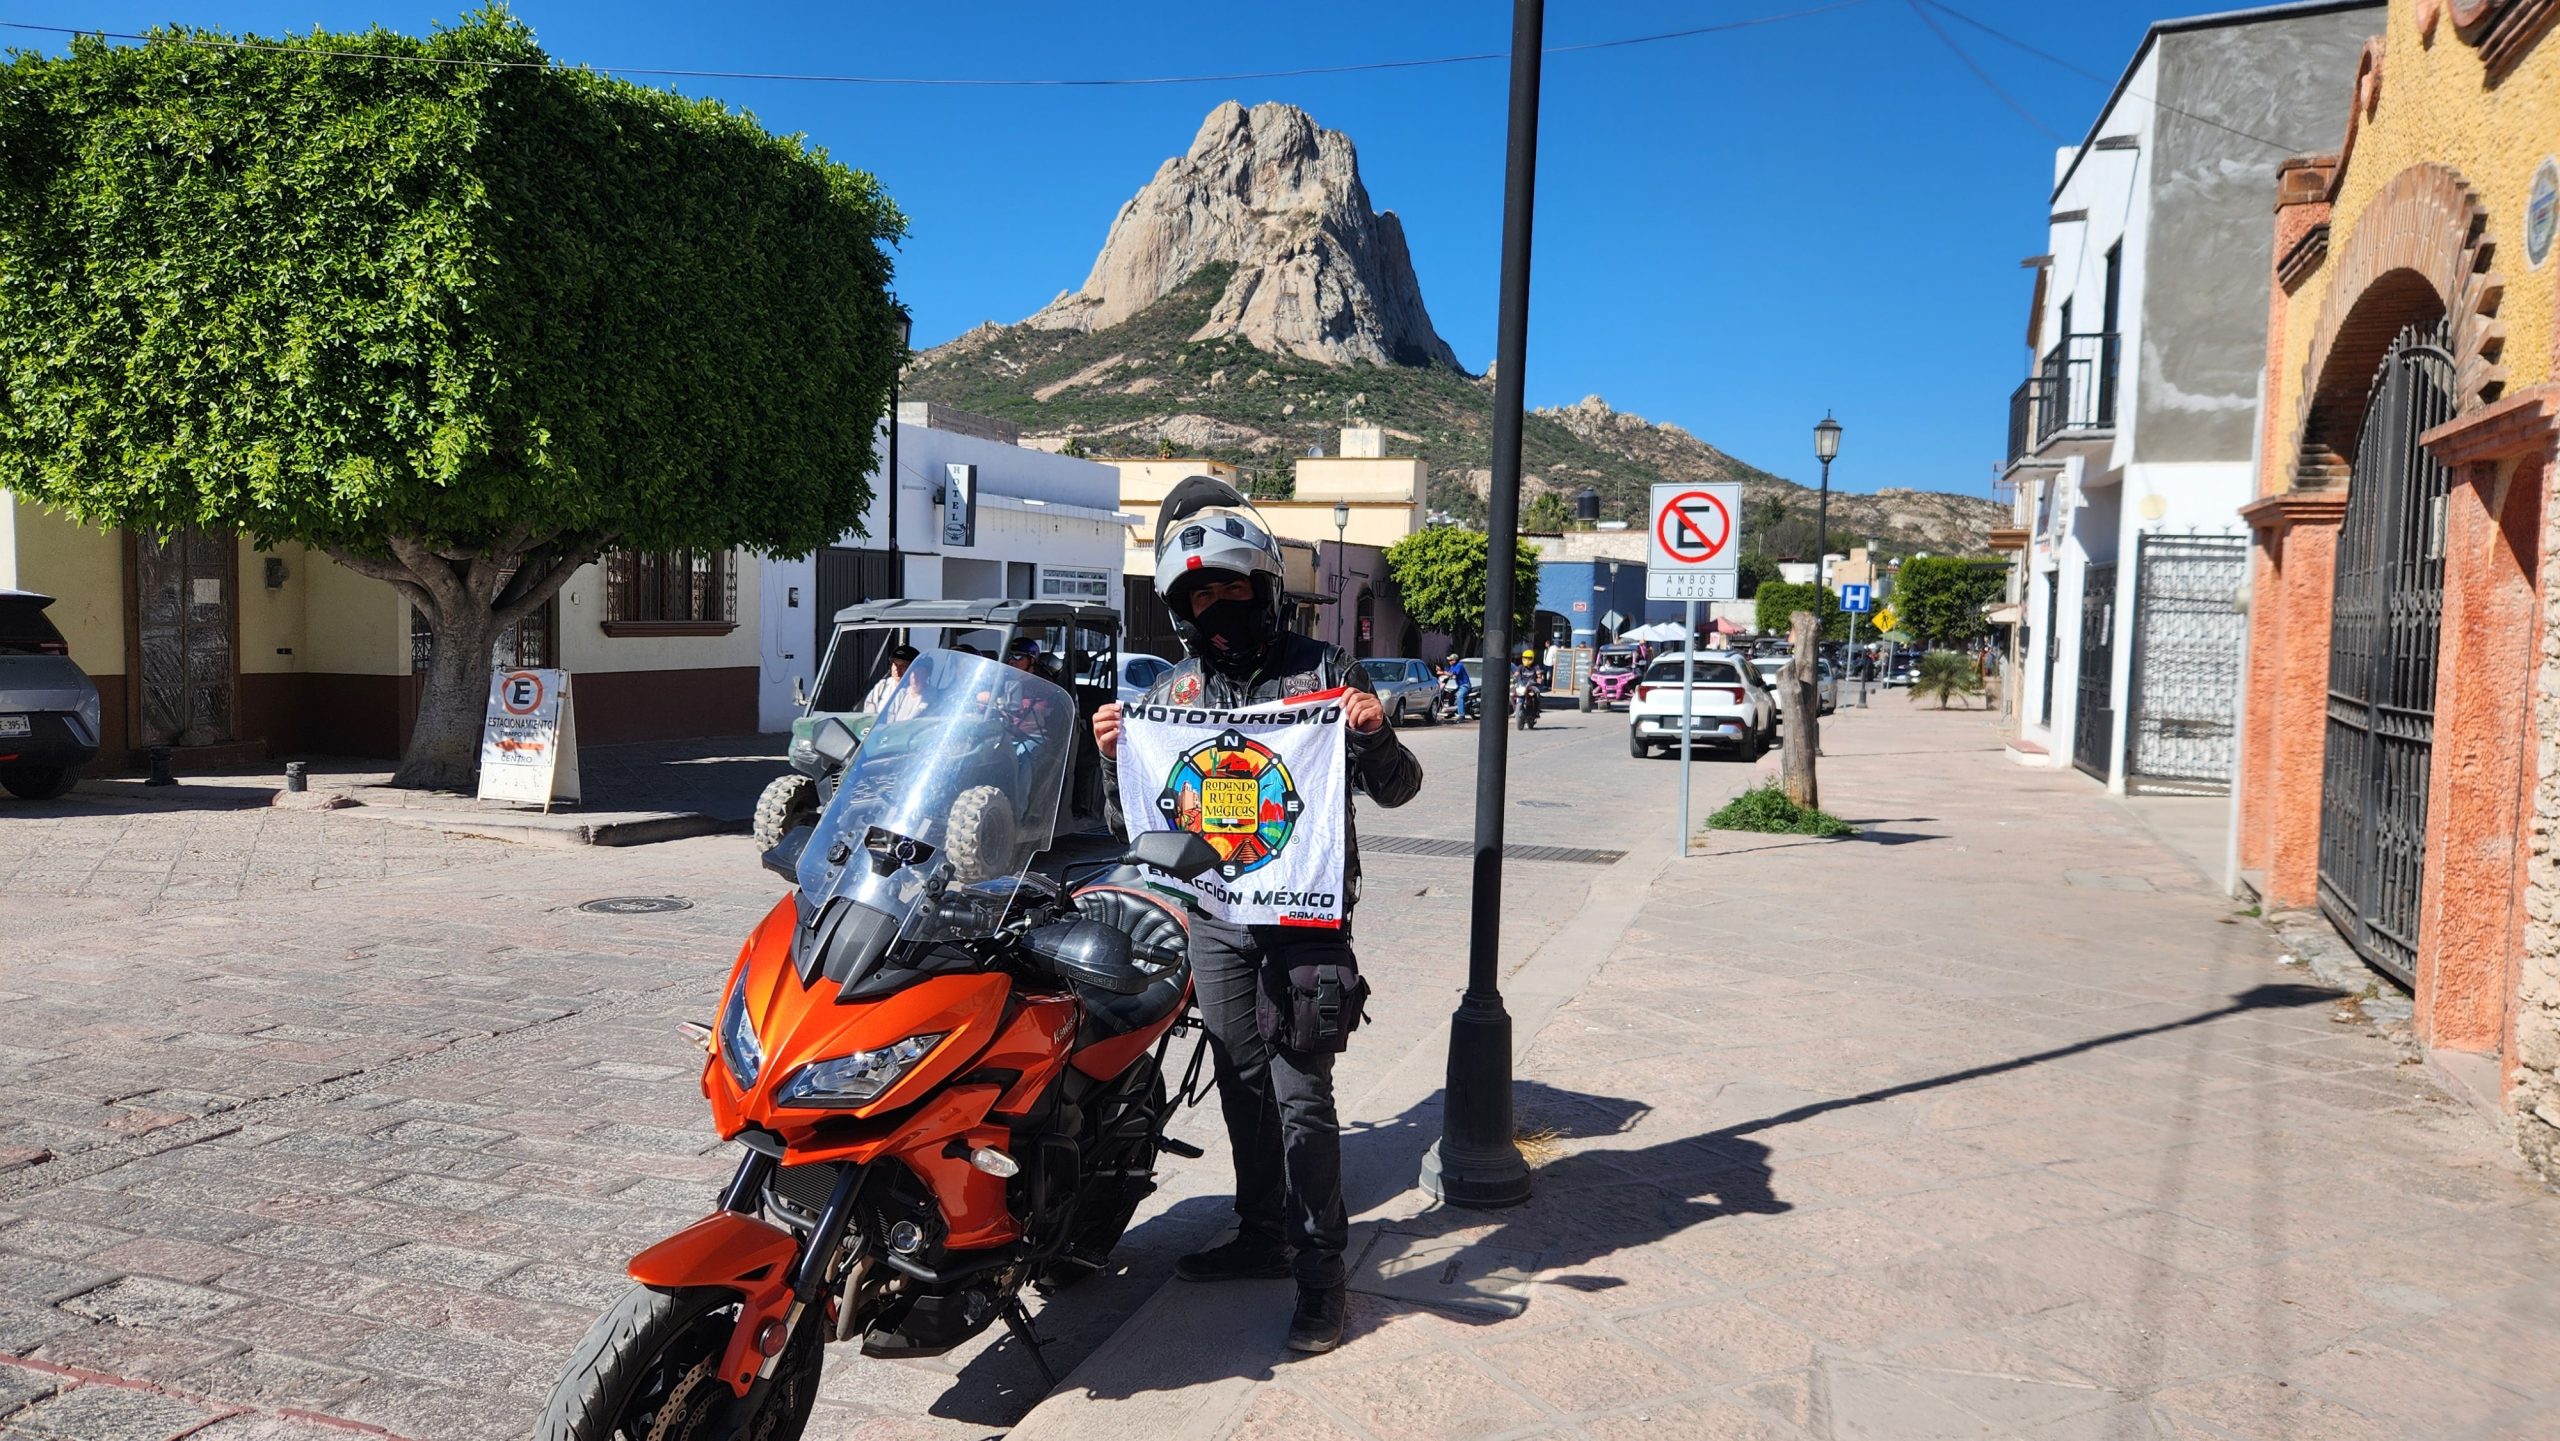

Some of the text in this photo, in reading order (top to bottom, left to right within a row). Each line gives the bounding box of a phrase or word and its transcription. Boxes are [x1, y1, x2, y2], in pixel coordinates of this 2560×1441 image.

[952, 466, 961, 521] HOTEL
[1677, 506, 1710, 548] E
[1667, 575, 1716, 585] AMBOS
[1667, 587, 1715, 598] LADOS
[1845, 587, 1866, 609] H
[513, 681, 531, 705] E
[1121, 702, 1341, 725] MOTOTURISMO
[488, 717, 553, 731] ESTACIONAMIENTO
[1224, 736, 1239, 747] N
[501, 754, 533, 763] CENTRO
[1287, 801, 1299, 812] E
[1223, 864, 1236, 877] S
[1186, 878, 1243, 905] CCIÓN
[1252, 886, 1335, 908] MÉXICO
[1318, 912, 1334, 921] 4.0
